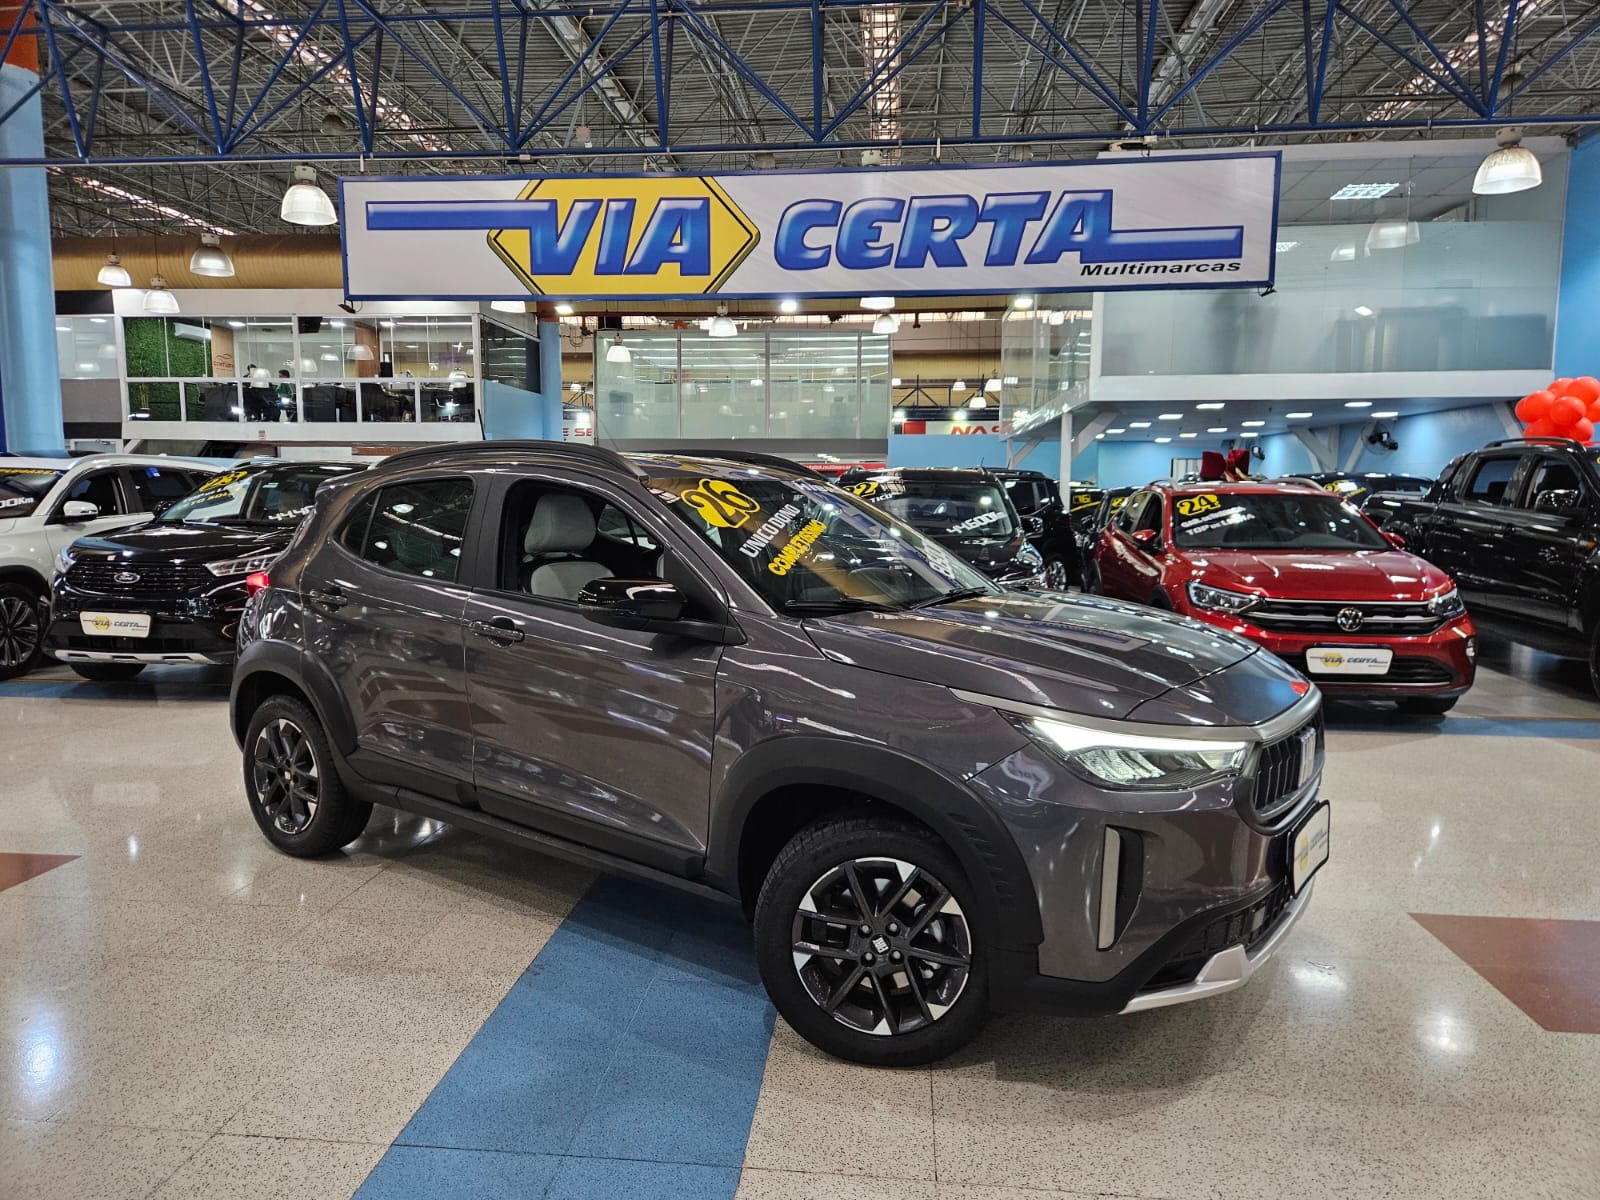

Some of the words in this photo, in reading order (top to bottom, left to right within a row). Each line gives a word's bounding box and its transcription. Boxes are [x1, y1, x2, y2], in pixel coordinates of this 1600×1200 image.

[505, 197, 711, 276] VIA
[774, 189, 1114, 270] CERTA
[1080, 261, 1241, 276] Multimarcas
[681, 479, 760, 528] 26
[1176, 494, 1221, 516] 24
[740, 522, 779, 557] UNICO
[768, 504, 800, 529] DONO
